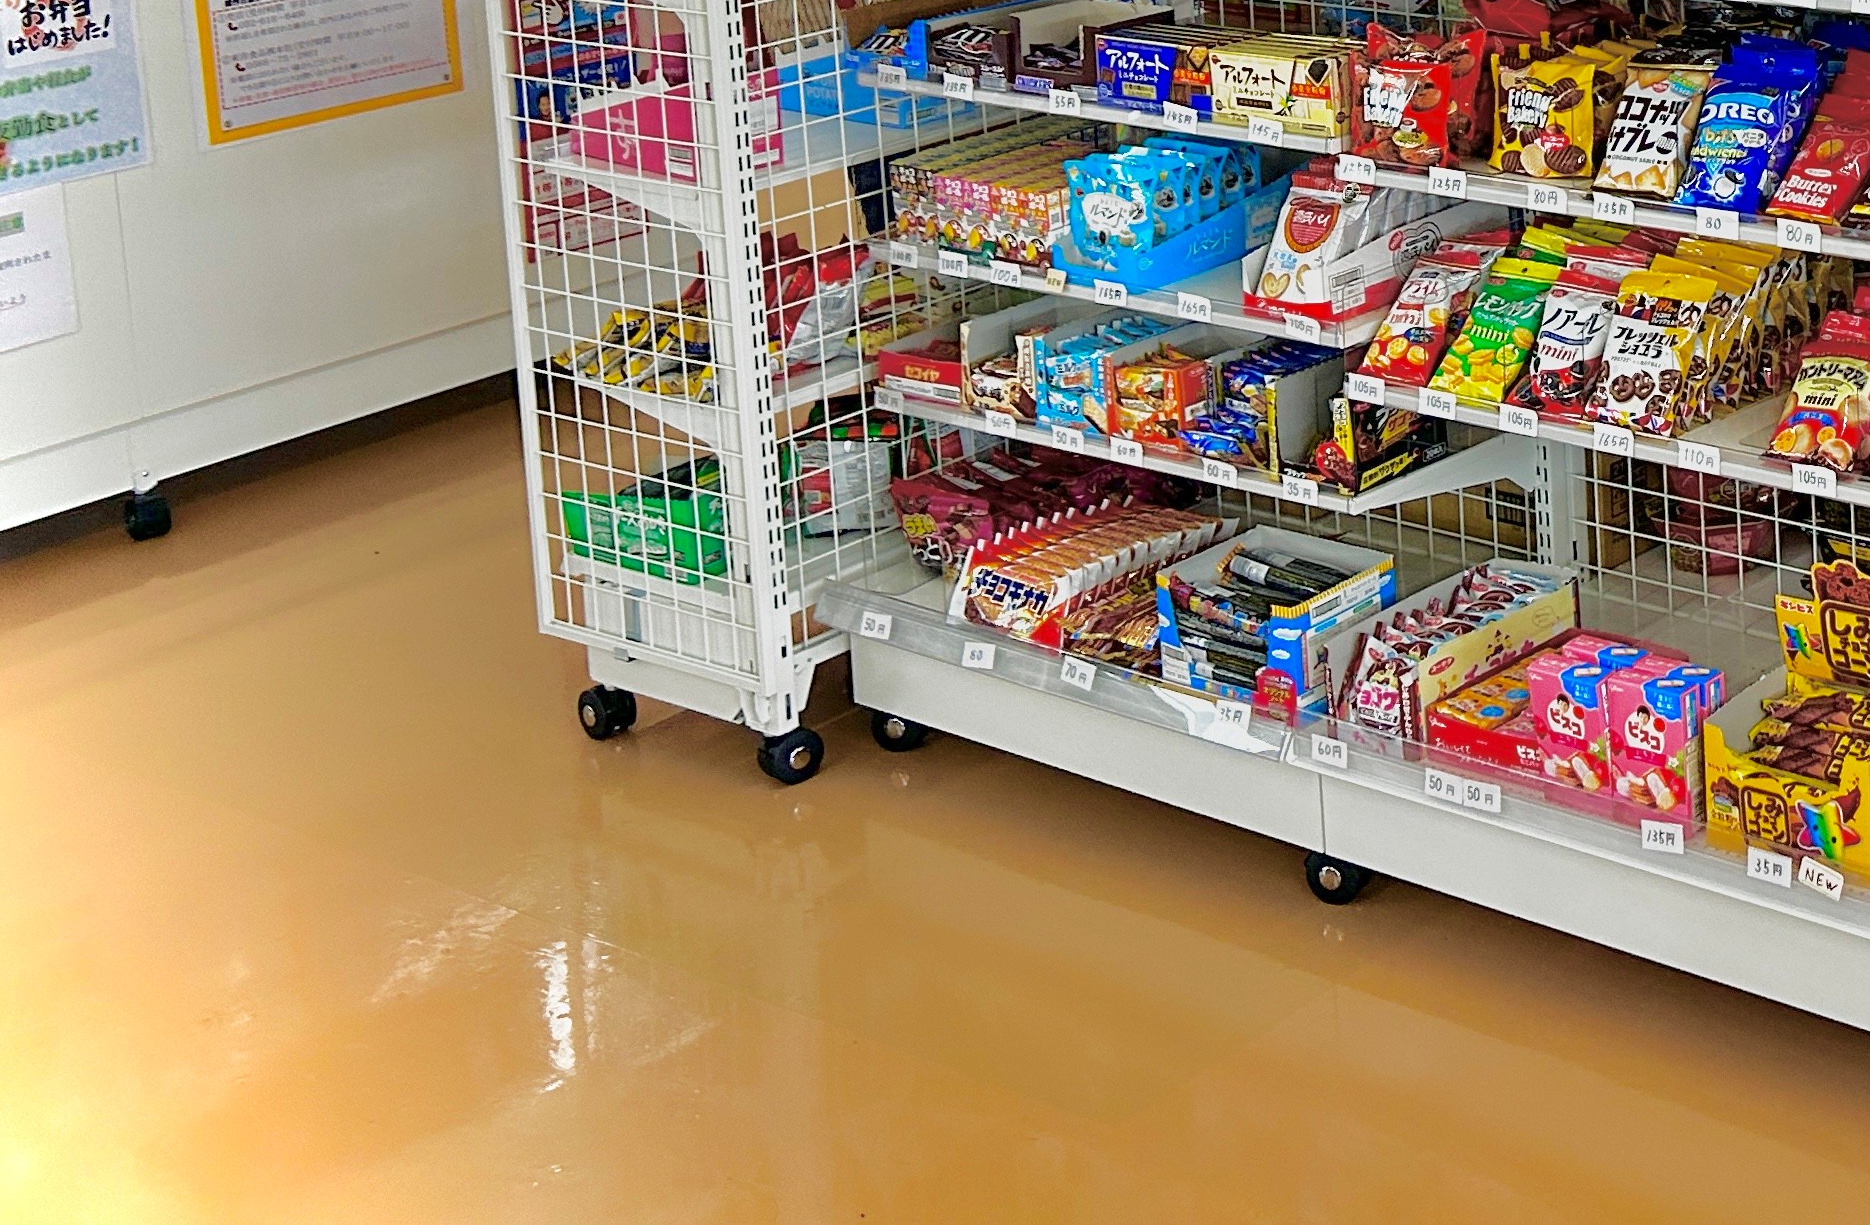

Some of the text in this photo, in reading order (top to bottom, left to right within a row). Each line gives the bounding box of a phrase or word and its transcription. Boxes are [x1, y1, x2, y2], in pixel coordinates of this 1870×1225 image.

[8, 13, 112, 56] はじめました!
[1105, 47, 1170, 72] アルフォート
[1223, 63, 1286, 89] アルフォート
[1699, 102, 1775, 125] OREO
[1253, 126, 1280, 141] 145円
[1433, 178, 1461, 192] 125円
[1786, 176, 1838, 195] Butter
[1535, 190, 1558, 204] 80円
[1778, 187, 1829, 209] Cookies
[1598, 203, 1627, 216] 135円
[1786, 226, 1814, 244] 80円
[993, 269, 1018, 284] 100円
[1182, 302, 1207, 316] 165円
[1470, 323, 1509, 343] mini
[1538, 342, 1579, 362] mini
[1354, 381, 1378, 398] 105円
[1425, 395, 1452, 413] 105円
[1804, 392, 1837, 408] mini
[1507, 410, 1533, 429] 105円
[1057, 432, 1078, 448] 50円
[1599, 435, 1630, 453] 165円
[1684, 449, 1715, 467] 110円
[1208, 465, 1231, 481] 60円
[1799, 470, 1827, 489] 105円
[1288, 483, 1311, 498] 35円
[864, 616, 886, 634] 50円
[1066, 665, 1088, 683] 70円
[1548, 707, 1583, 738] ビスコ
[1627, 720, 1661, 751] ビスコ
[1318, 744, 1341, 760] 60円
[1429, 777, 1455, 798] 50円
[1468, 786, 1494, 805] 50円
[1647, 829, 1676, 847] 135円
[1755, 858, 1783, 878] 35円
[1806, 869, 1839, 891] NEW
